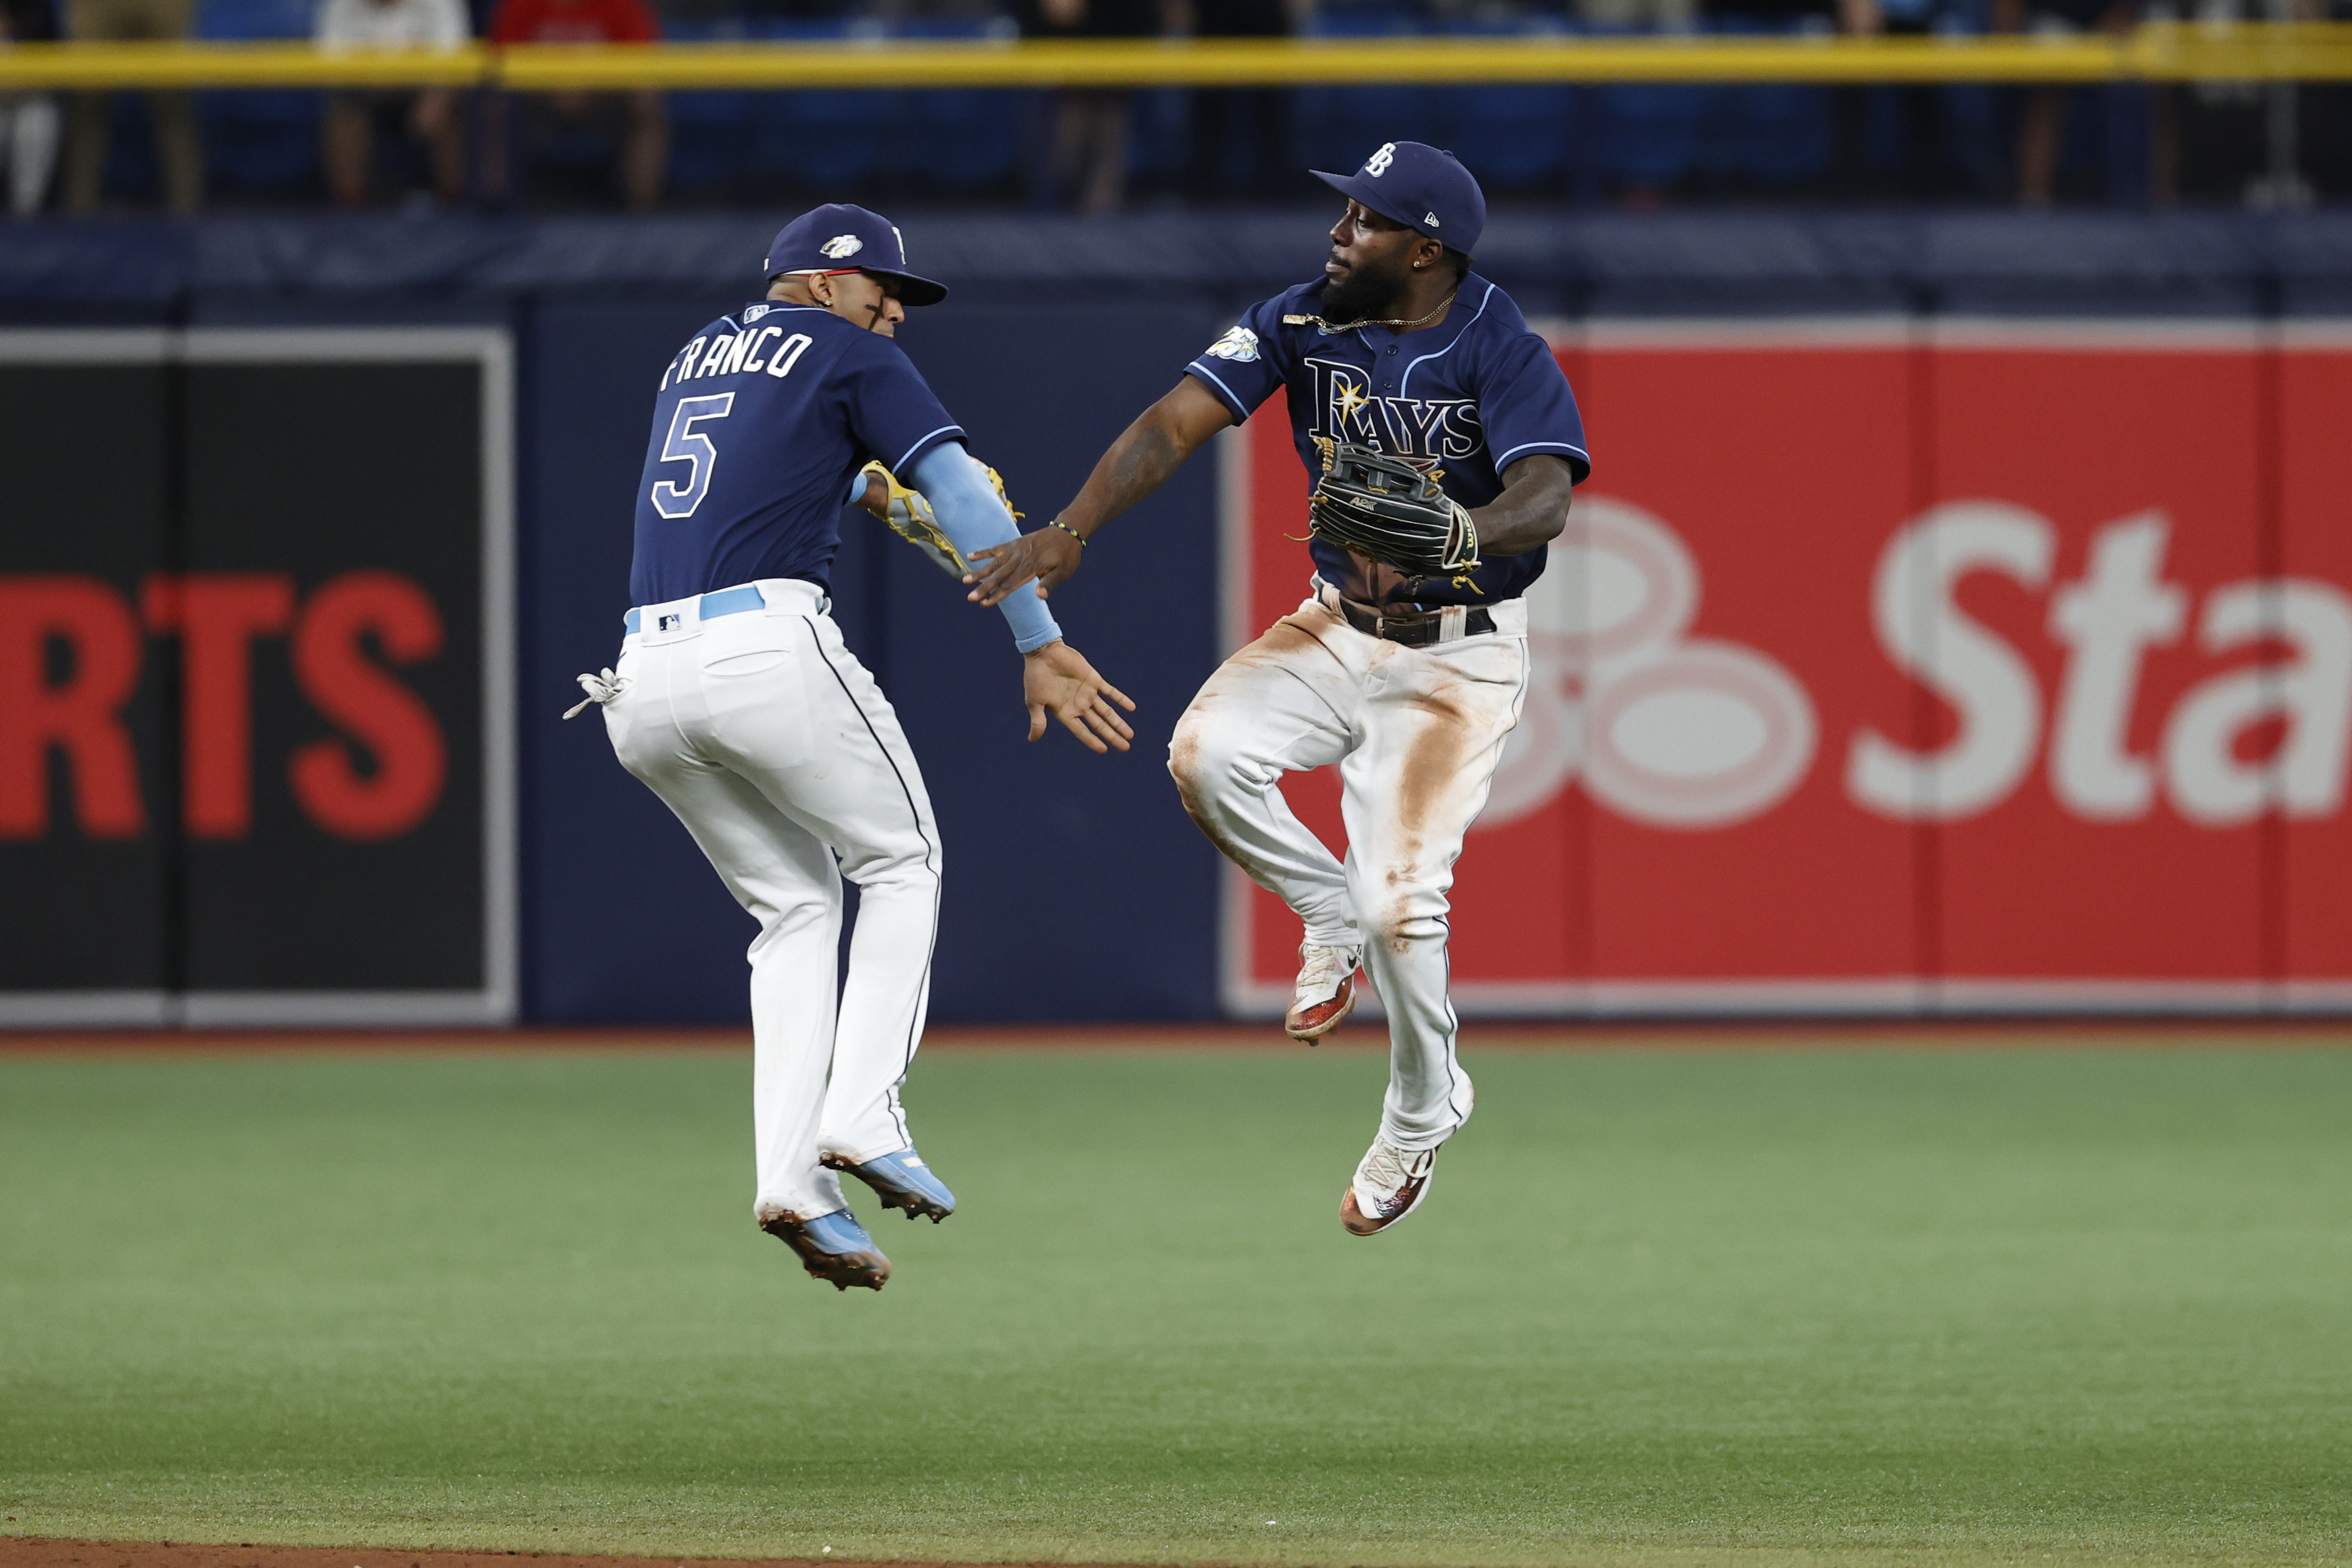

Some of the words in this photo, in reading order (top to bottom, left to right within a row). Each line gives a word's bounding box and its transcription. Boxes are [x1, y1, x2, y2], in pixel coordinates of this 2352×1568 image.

[660, 326, 813, 392] FRANCO
[650, 392, 736, 519] 5
[1349, 496, 1378, 511] A2K
[0, 572, 447, 840] RTS
[1843, 498, 2352, 827] Sta
